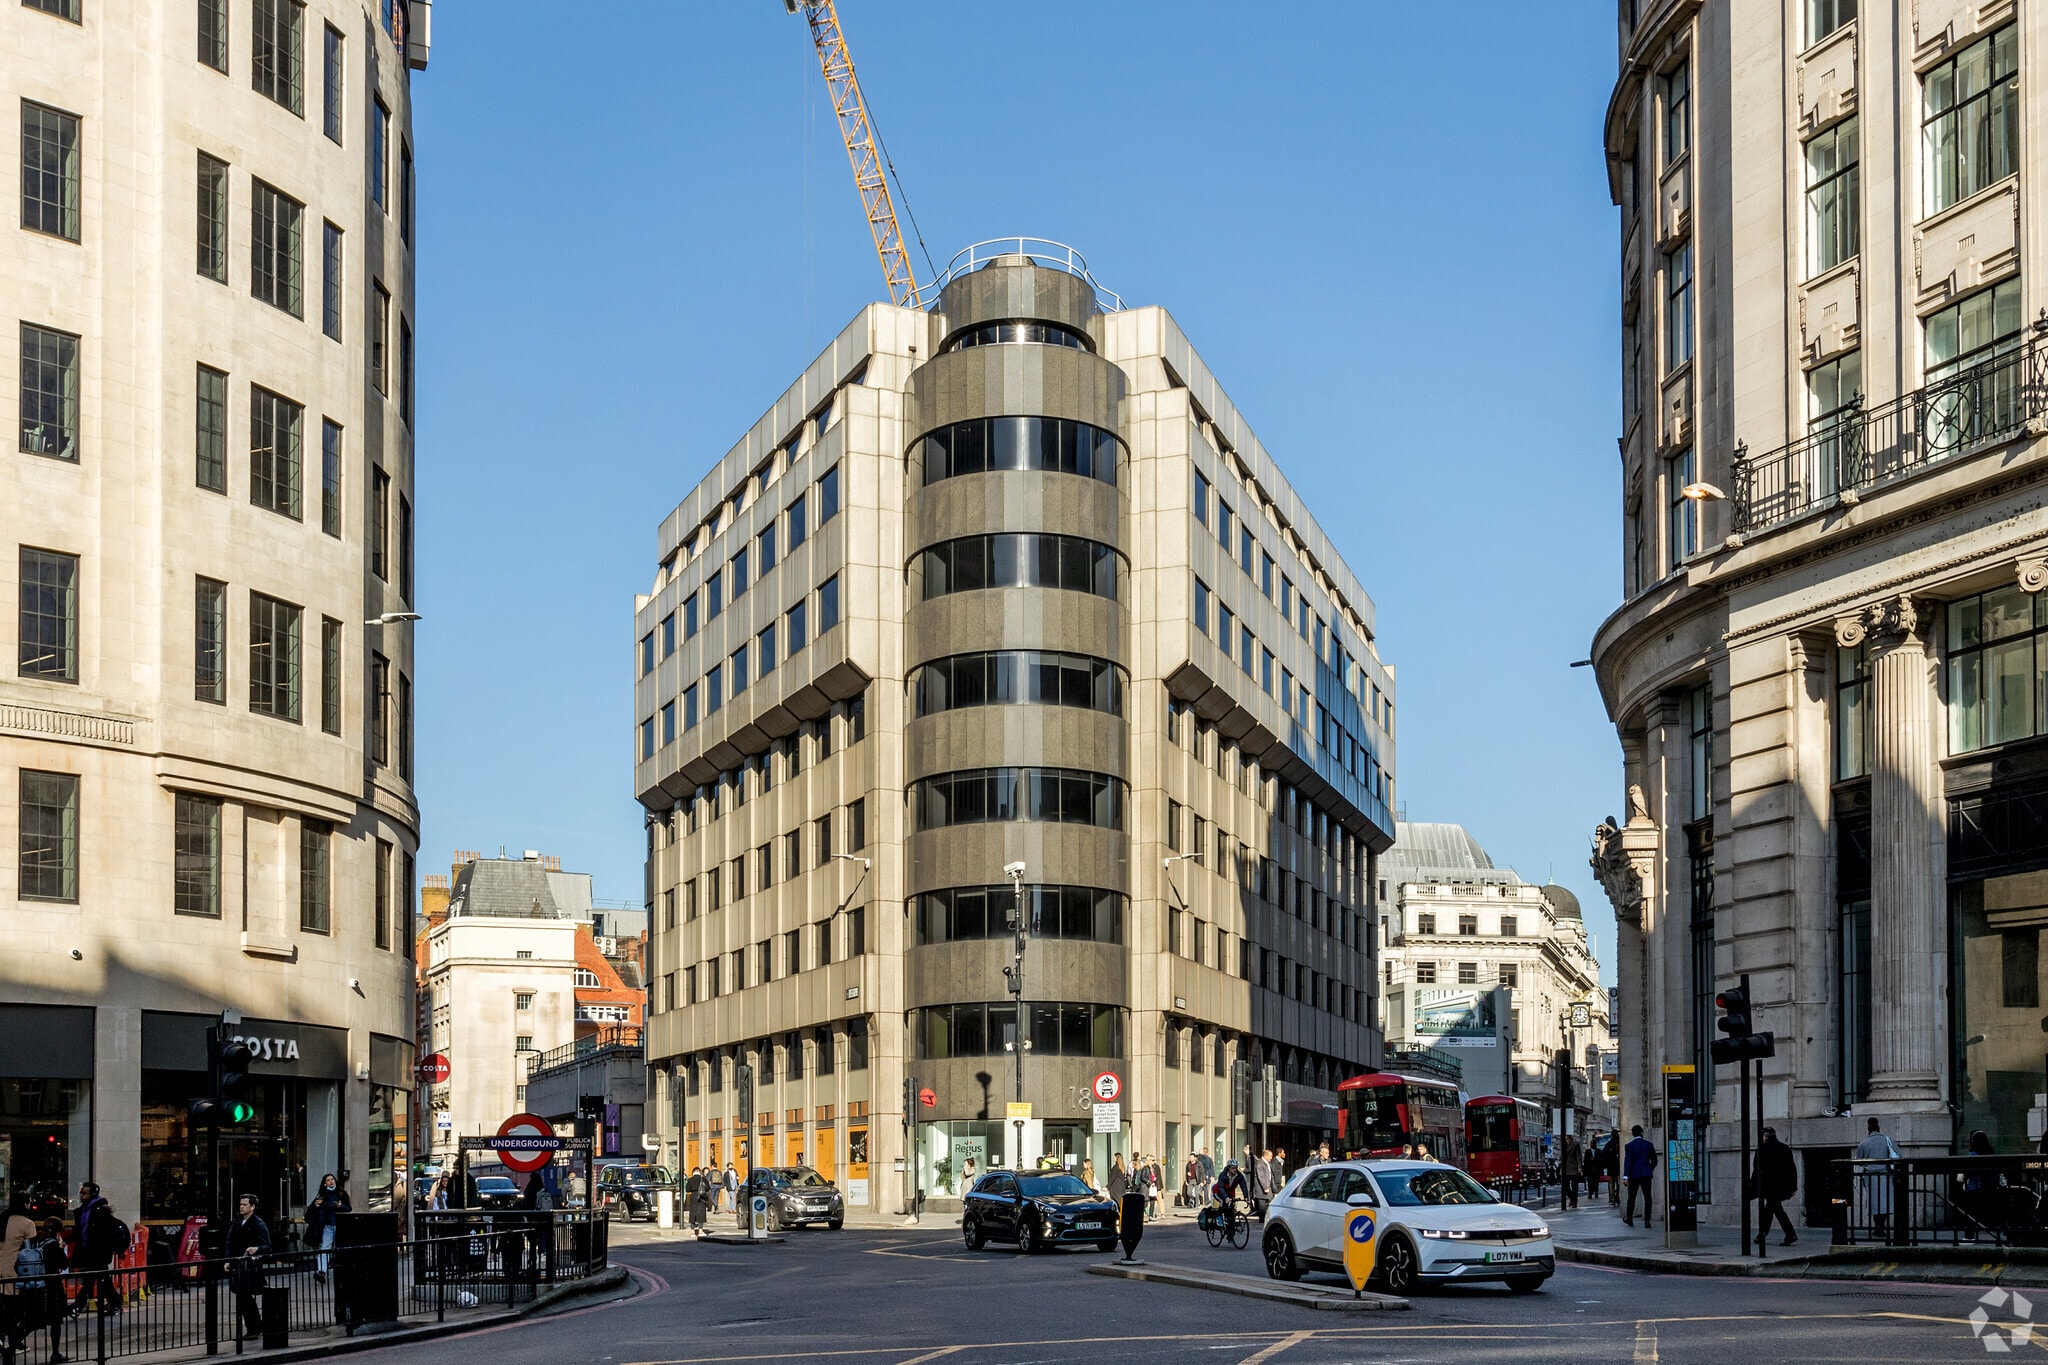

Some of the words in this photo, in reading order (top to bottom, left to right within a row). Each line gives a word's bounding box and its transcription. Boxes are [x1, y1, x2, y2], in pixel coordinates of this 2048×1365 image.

[1069, 1086, 1092, 1111] 18
[1366, 1101, 1378, 1111] 733
[490, 1139, 560, 1148] UNDERGROUND
[955, 1141, 983, 1157] Regus
